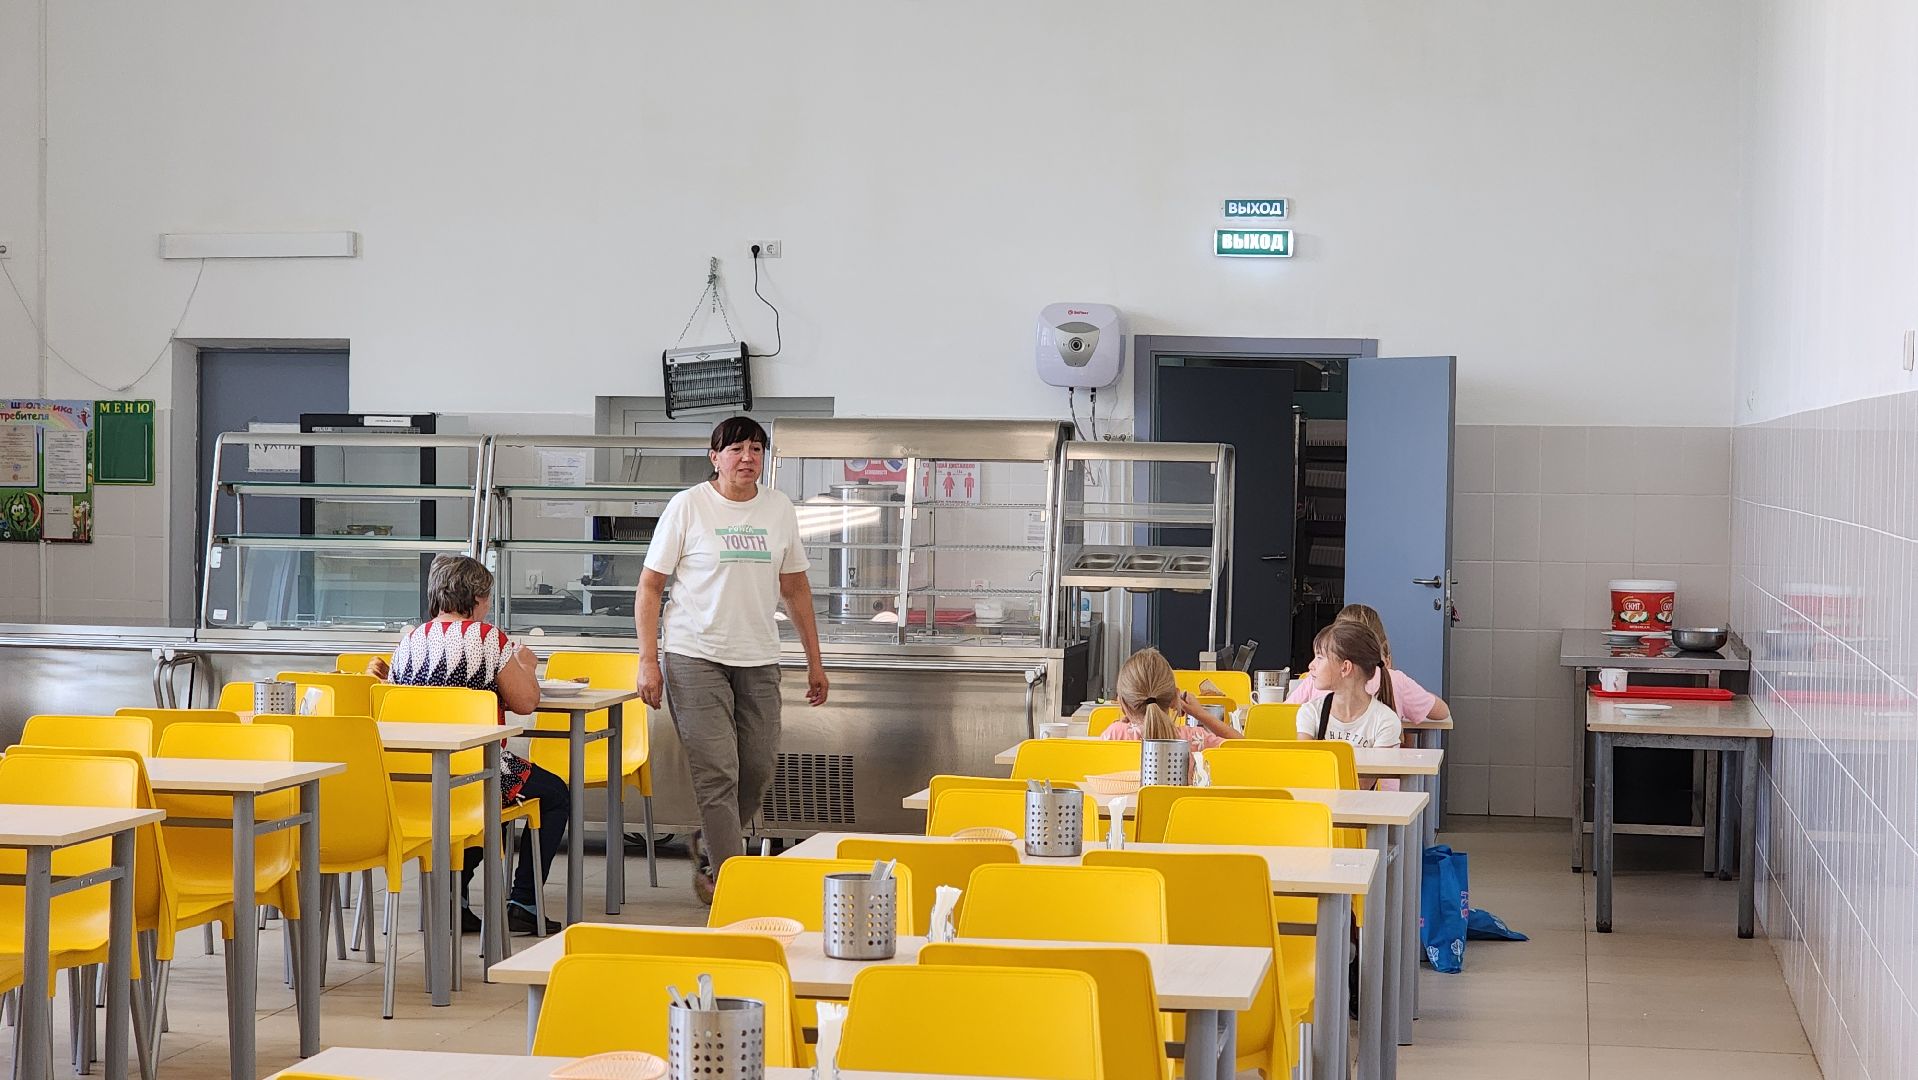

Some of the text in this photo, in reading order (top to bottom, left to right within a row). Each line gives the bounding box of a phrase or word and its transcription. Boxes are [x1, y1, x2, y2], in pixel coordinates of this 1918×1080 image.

[1228, 202, 1282, 215] ВЫХОД
[1221, 233, 1284, 251] ВЫХОД
[100, 402, 150, 414] МЕНЮ
[0, 410, 49, 422] требителя
[721, 534, 768, 551] YOUTH
[1329, 730, 1369, 748] HLETIC
